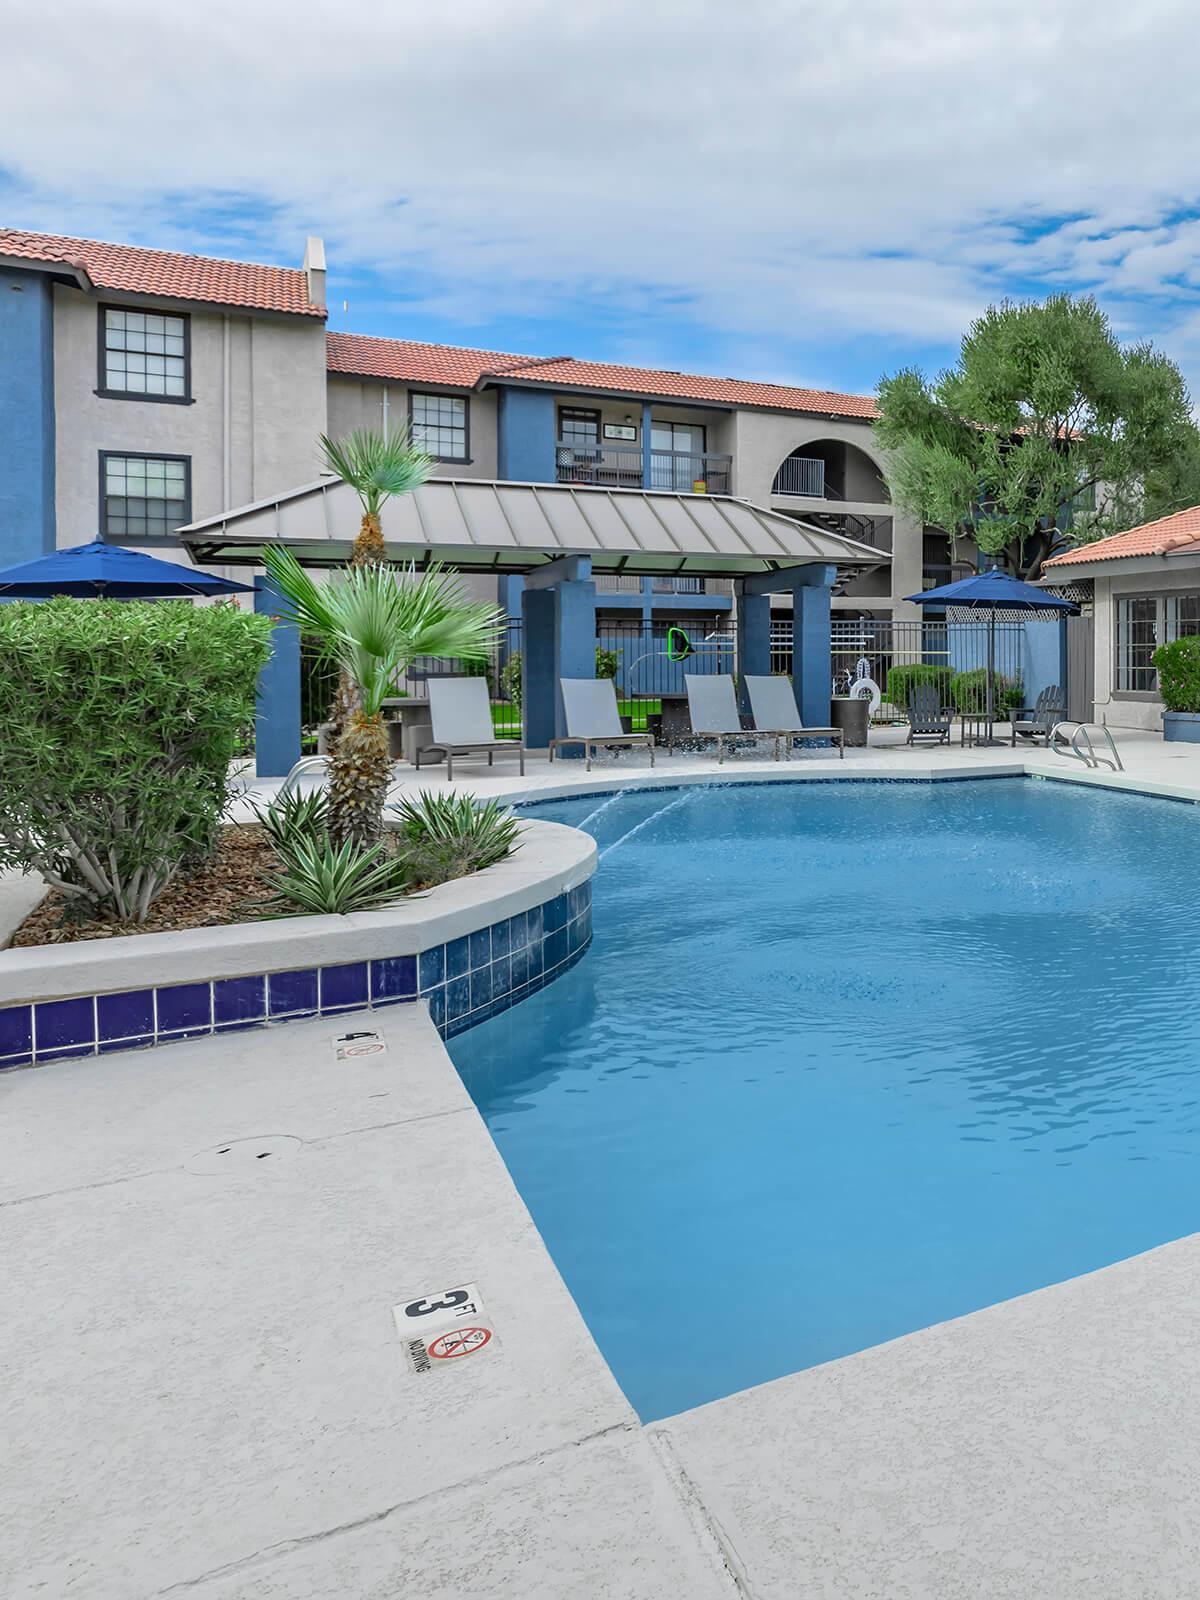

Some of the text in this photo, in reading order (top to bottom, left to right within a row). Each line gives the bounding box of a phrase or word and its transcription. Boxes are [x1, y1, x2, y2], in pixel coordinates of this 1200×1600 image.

[405, 1290, 477, 1317] 3 FT
[407, 1338, 431, 1373] NO DIVING
